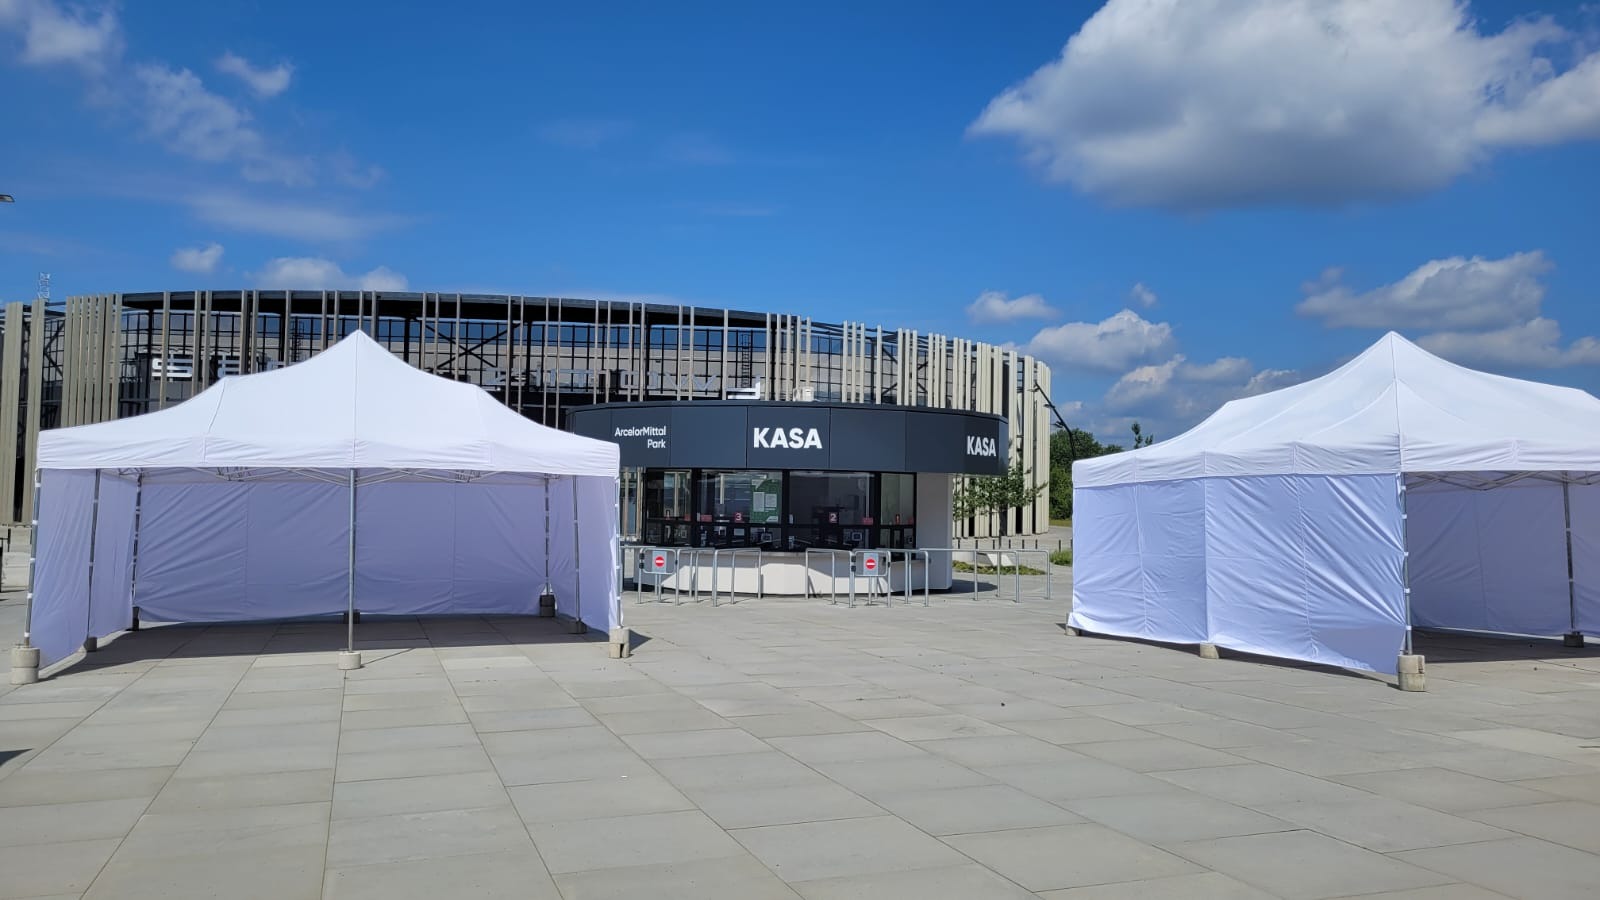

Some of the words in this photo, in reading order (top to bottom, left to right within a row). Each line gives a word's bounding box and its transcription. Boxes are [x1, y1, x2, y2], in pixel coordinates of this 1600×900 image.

[614, 425, 667, 437] ArcelorMittal
[647, 438, 666, 449] Park
[753, 427, 823, 449] KASA
[966, 435, 997, 457] KASA
[735, 512, 742, 521] 3
[830, 513, 837, 523] 2
